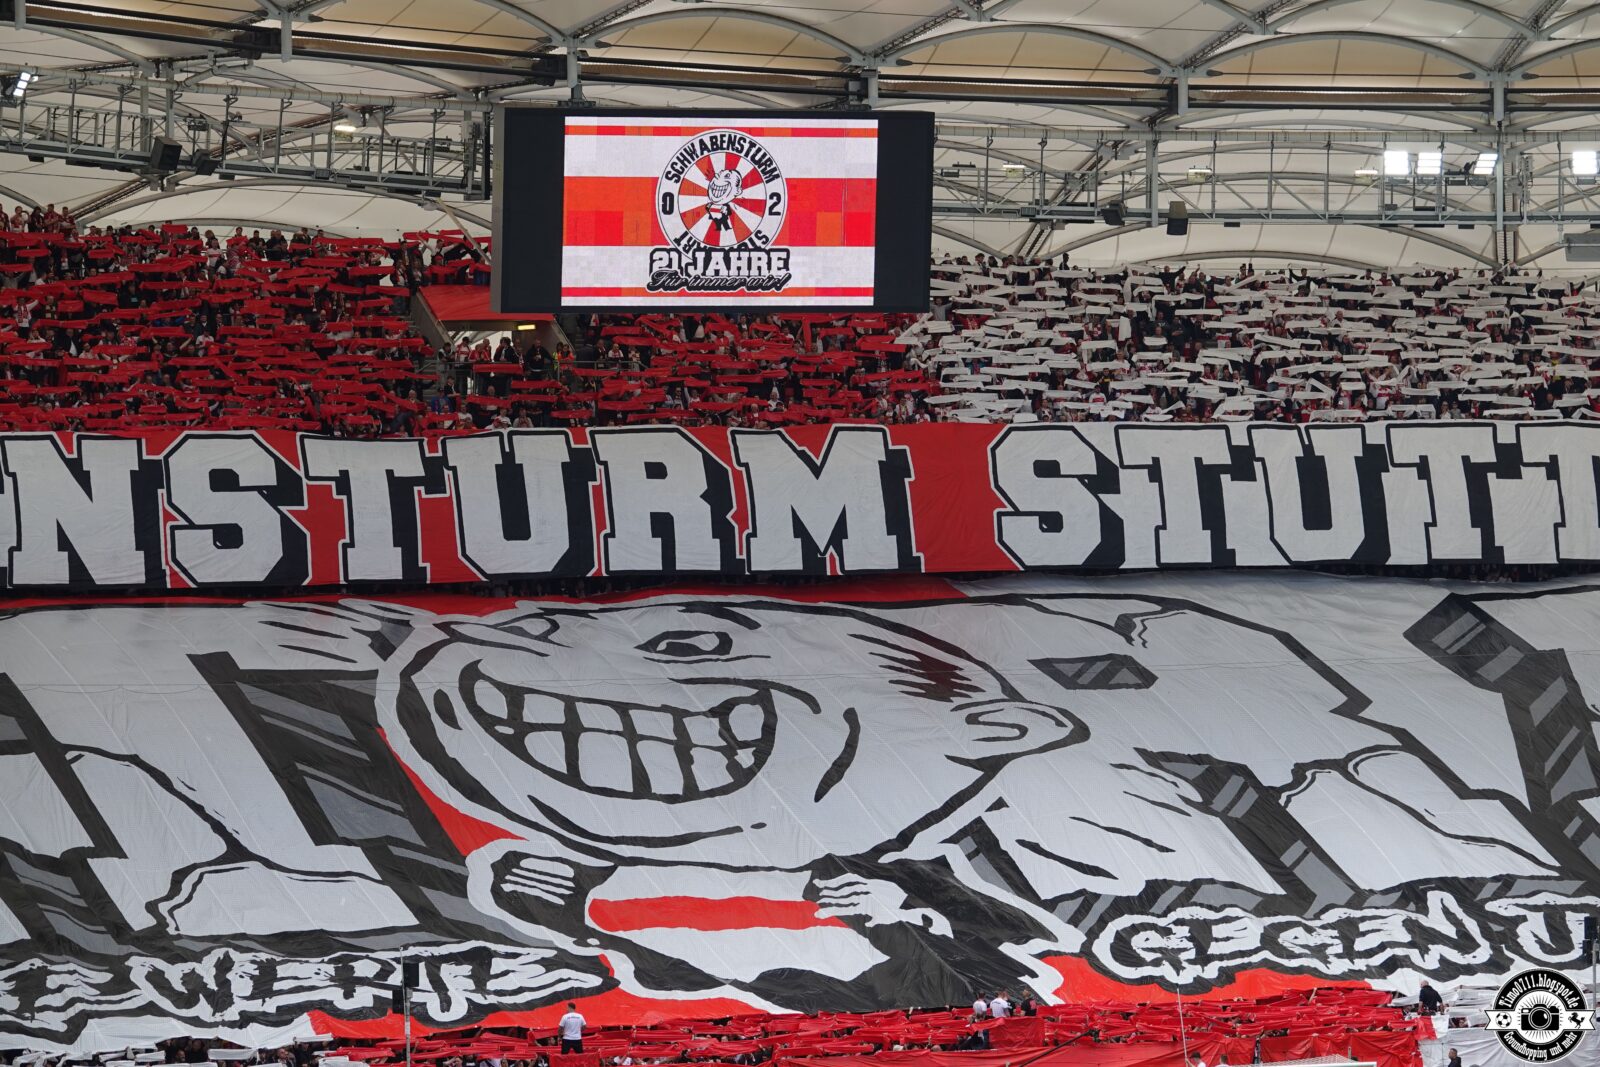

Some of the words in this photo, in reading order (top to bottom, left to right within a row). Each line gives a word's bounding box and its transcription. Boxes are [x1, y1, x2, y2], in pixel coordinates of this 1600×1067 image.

[665, 134, 781, 184] SCHWABENSTURM
[768, 191, 781, 216] 2
[651, 249, 682, 273] 21
[687, 249, 788, 276] JAHRE
[649, 269, 687, 289] Für
[687, 274, 745, 289] immer
[1092, 890, 1494, 984] GEGEN
